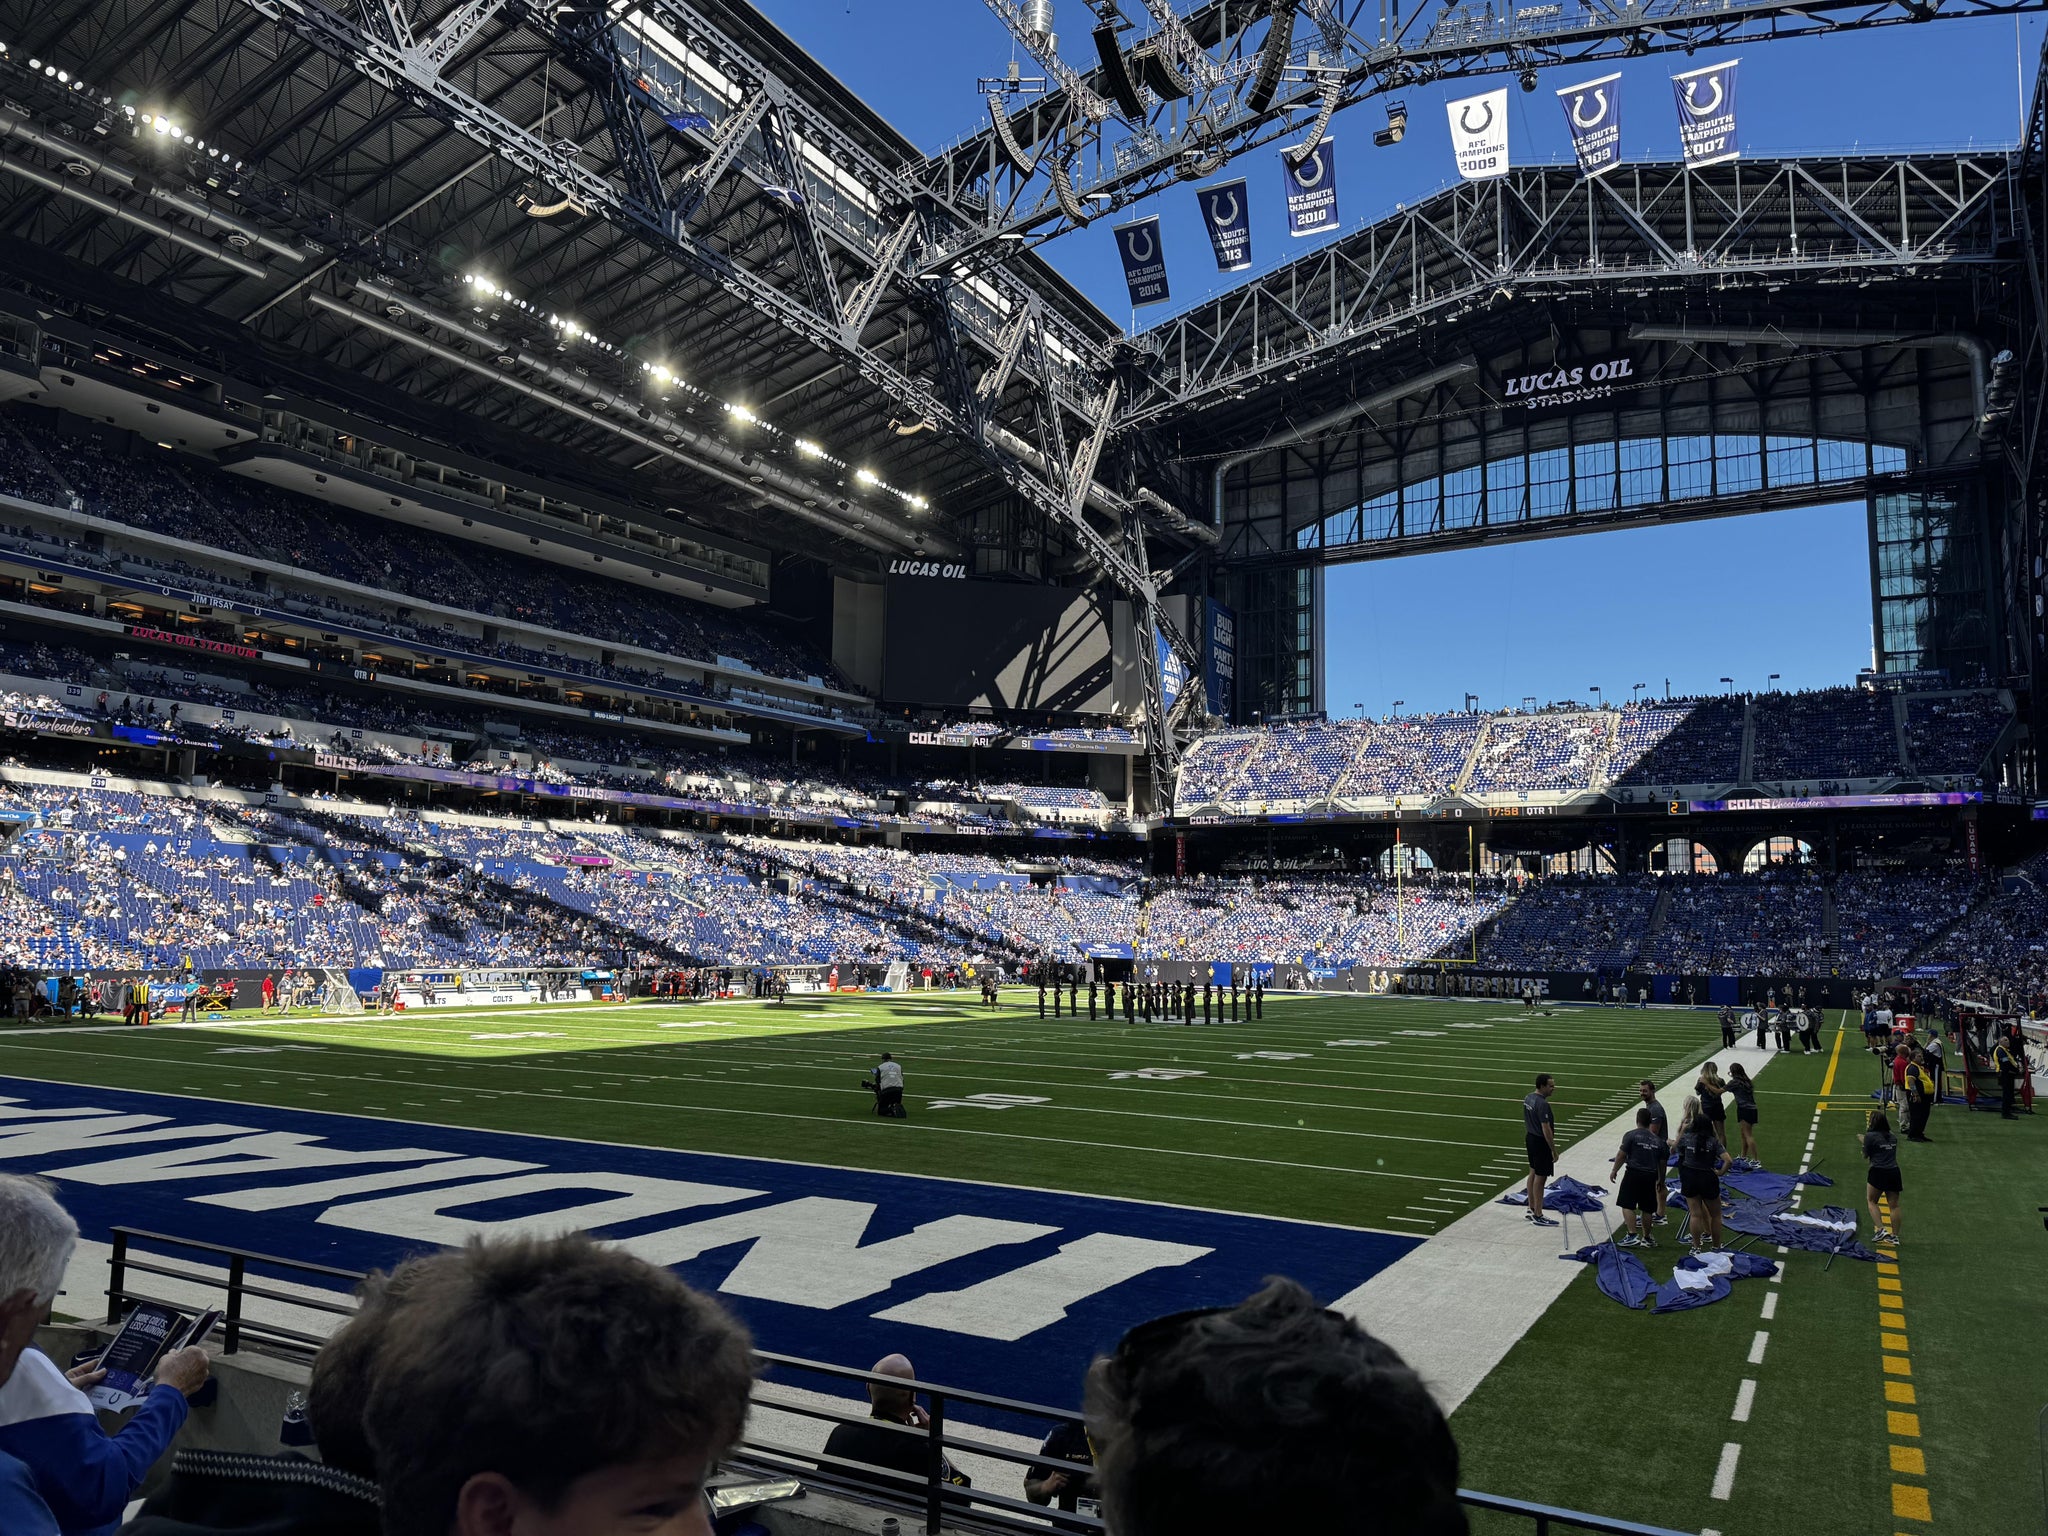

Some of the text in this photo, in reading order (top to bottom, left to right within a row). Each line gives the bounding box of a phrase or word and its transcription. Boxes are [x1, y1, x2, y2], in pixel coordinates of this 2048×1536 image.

[1697, 114, 1733, 131] SOUTH
[1585, 124, 1617, 143] SOUTH
[1681, 122, 1735, 142] AMPIONS
[1458, 143, 1505, 158] AMPIONS
[1468, 139, 1486, 149] AFC
[1684, 136, 1725, 158] 2007
[1460, 156, 1497, 171] 2009
[1288, 187, 1333, 204] AFC SOUTH
[1289, 195, 1335, 212] CHAMPIONS
[1297, 208, 1327, 226] 2010
[1222, 227, 1247, 240] SOUTH
[1219, 248, 1242, 263] 2013
[1127, 263, 1163, 278] AFC SOUTH
[1128, 270, 1166, 286] CHAMPIONS
[1138, 282, 1161, 297] 2014
[1504, 358, 1634, 396] LUCAS OIL
[1527, 384, 1612, 410] STADIUM
[888, 559, 966, 579] LUCAS OIL
[191, 594, 235, 610] JIM IRSAY
[1215, 613, 1234, 634] BUD
[131, 625, 258, 659] LUCAS OIL STADIUM
[1213, 625, 1235, 649] LIGHT
[1213, 646, 1235, 667] PARTY
[354, 669, 367, 680] QTR
[1215, 660, 1234, 680] ZONE
[66, 685, 82, 697] 339
[594, 711, 622, 722] BUD LIGHT
[17, 713, 92, 737] Cheerleaders
[909, 732, 946, 746] COLT
[314, 753, 358, 771] COLTS
[91, 777, 106, 789] 239
[569, 785, 604, 800] COLTS
[1728, 798, 1825, 811] COLTS Cheerleaders
[1996, 795, 2022, 806] COLTS
[769, 809, 795, 821] COLTS
[1395, 809, 1402, 818] 0
[1455, 809, 1462, 818] 0
[1487, 807, 1519, 817] 17:58
[1526, 807, 1545, 816] QTR
[1190, 815, 1219, 825] COLTS
[956, 826, 987, 836] COLTS
[1968, 821, 1976, 855] LUCAS
[352, 851, 364, 859] 140
[1248, 860, 1282, 870] LUCS
[1898, 1019, 1907, 1028] G
[926, 1093, 1054, 1111] 10
[134, 1312, 169, 1329] MORE COLTS.
[128, 1320, 144, 1332] LESS
[140, 1323, 169, 1340] LAUNDRY.
